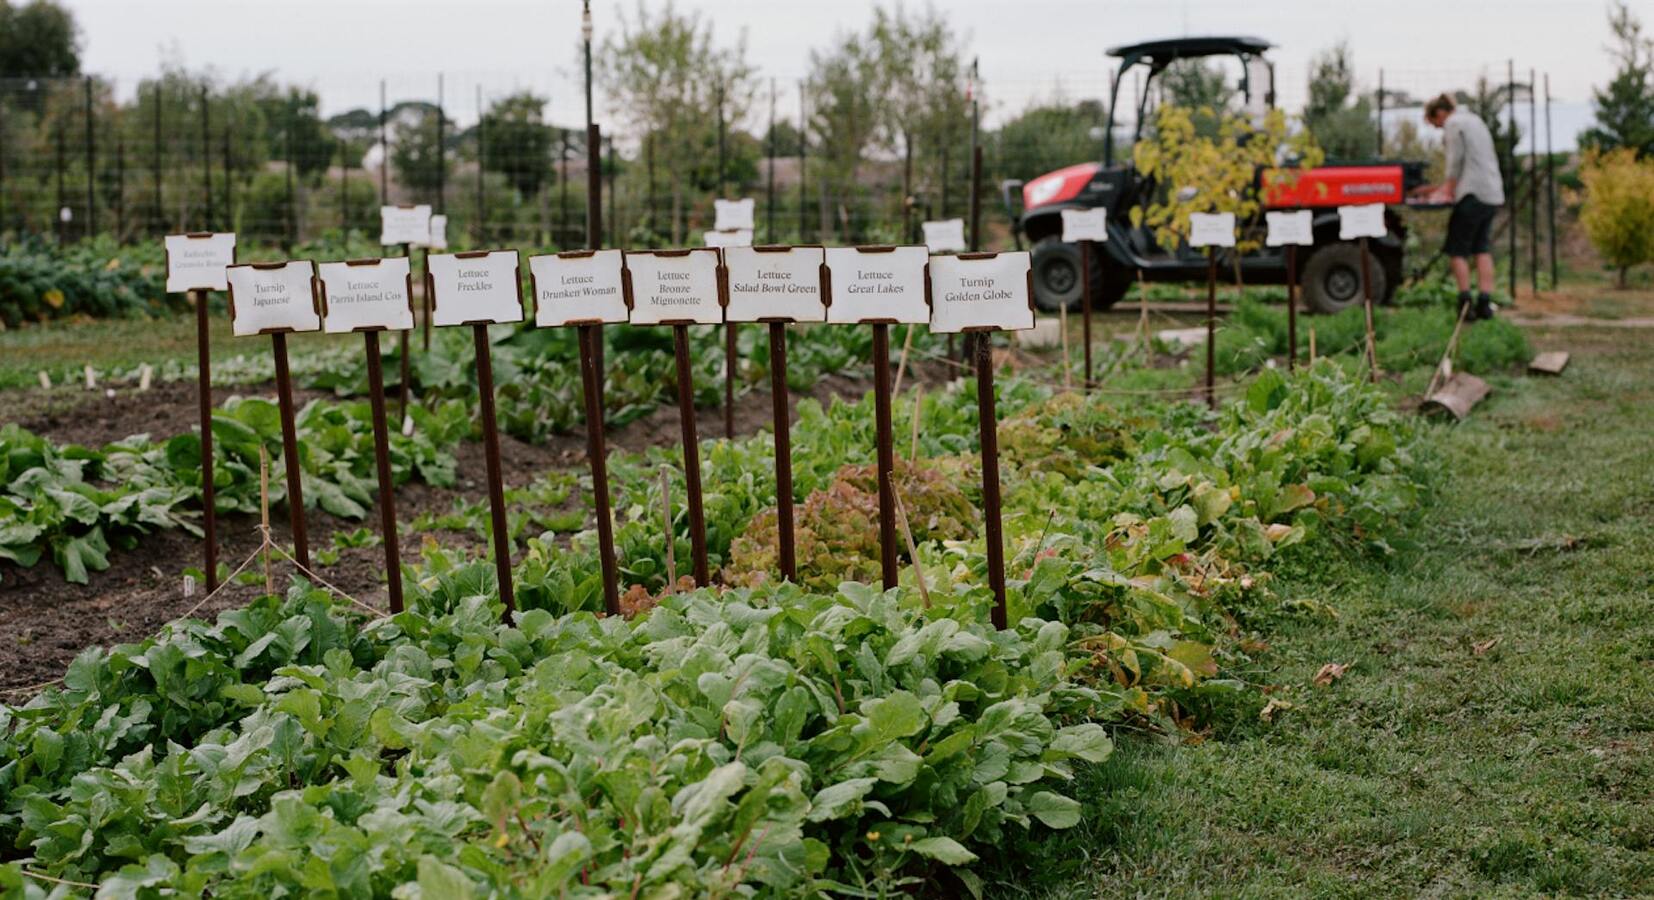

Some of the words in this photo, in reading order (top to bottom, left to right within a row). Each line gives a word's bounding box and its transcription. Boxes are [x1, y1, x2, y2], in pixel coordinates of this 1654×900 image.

[458, 269, 489, 278] Lettuce
[657, 271, 690, 280] Lettuce
[757, 269, 792, 279] Lettuce
[858, 270, 893, 280] Lettuce
[347, 280, 380, 290] Lettuce
[560, 274, 594, 285] Lettuce
[960, 276, 994, 288] Turnip
[254, 283, 286, 294] Turnip
[458, 280, 493, 292] Freckles
[659, 284, 692, 294] Bronze
[733, 283, 759, 293] Salad
[761, 283, 786, 293] Bowl
[788, 284, 817, 294] Green
[848, 284, 874, 294] Great
[877, 284, 904, 294] Lakes
[330, 294, 354, 304] Parris
[356, 292, 382, 303] Island
[385, 290, 402, 301] Cos
[542, 288, 582, 300] Drunken
[583, 286, 616, 296] Woman
[945, 291, 980, 302] Golden
[982, 290, 1013, 300] Globe
[252, 296, 291, 307] Japanese
[650, 296, 701, 307] Mignonette
